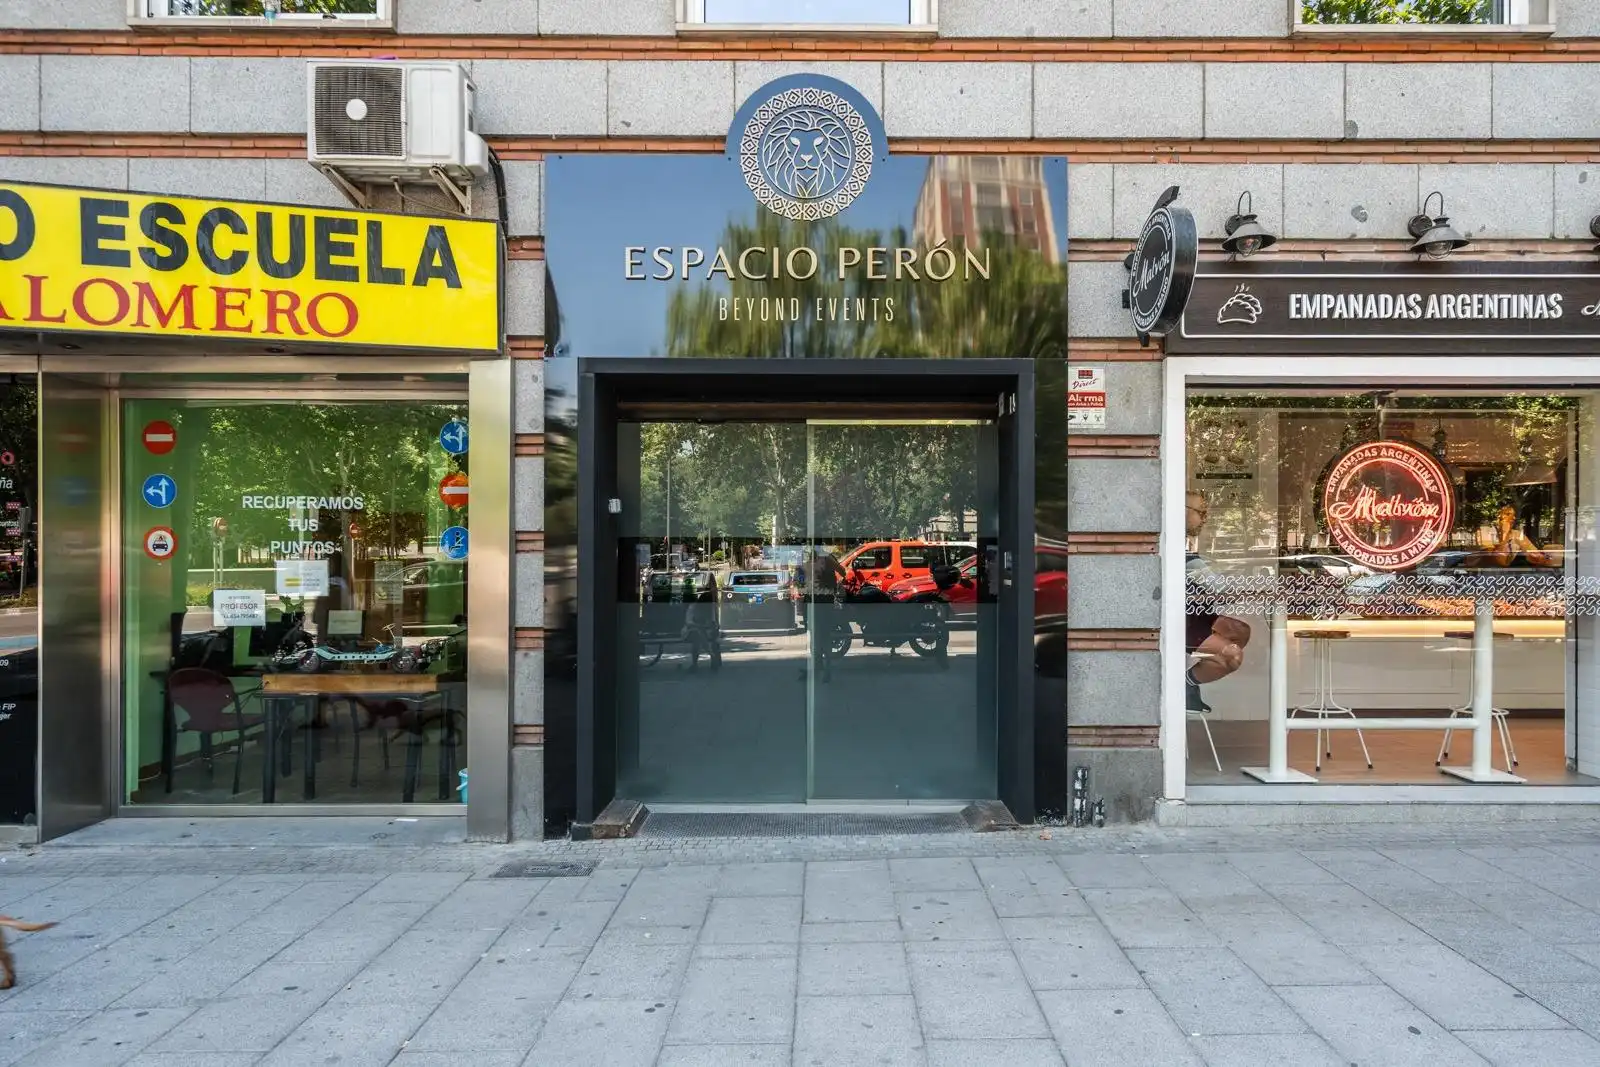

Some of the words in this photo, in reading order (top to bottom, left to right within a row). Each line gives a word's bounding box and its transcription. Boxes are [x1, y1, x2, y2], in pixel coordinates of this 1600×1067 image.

[80, 197, 463, 289] ESCUELA
[624, 246, 818, 281] ESPACIO
[838, 237, 992, 281] PERÓN
[718, 296, 800, 322] BEYOND
[815, 296, 896, 322] EVENTS
[1288, 293, 1421, 320] EMPANADAS
[1424, 293, 1564, 320] ARGENTINAS
[1328, 448, 1378, 493] EMPANADAS
[1380, 448, 1441, 493] ARGENTINAS
[242, 495, 364, 510] RECUPERAMOS
[288, 518, 319, 531] TUS
[270, 540, 335, 554] PUNTOS
[1333, 528, 1400, 565] ELABORADAS
[1408, 529, 1437, 558] MANO
